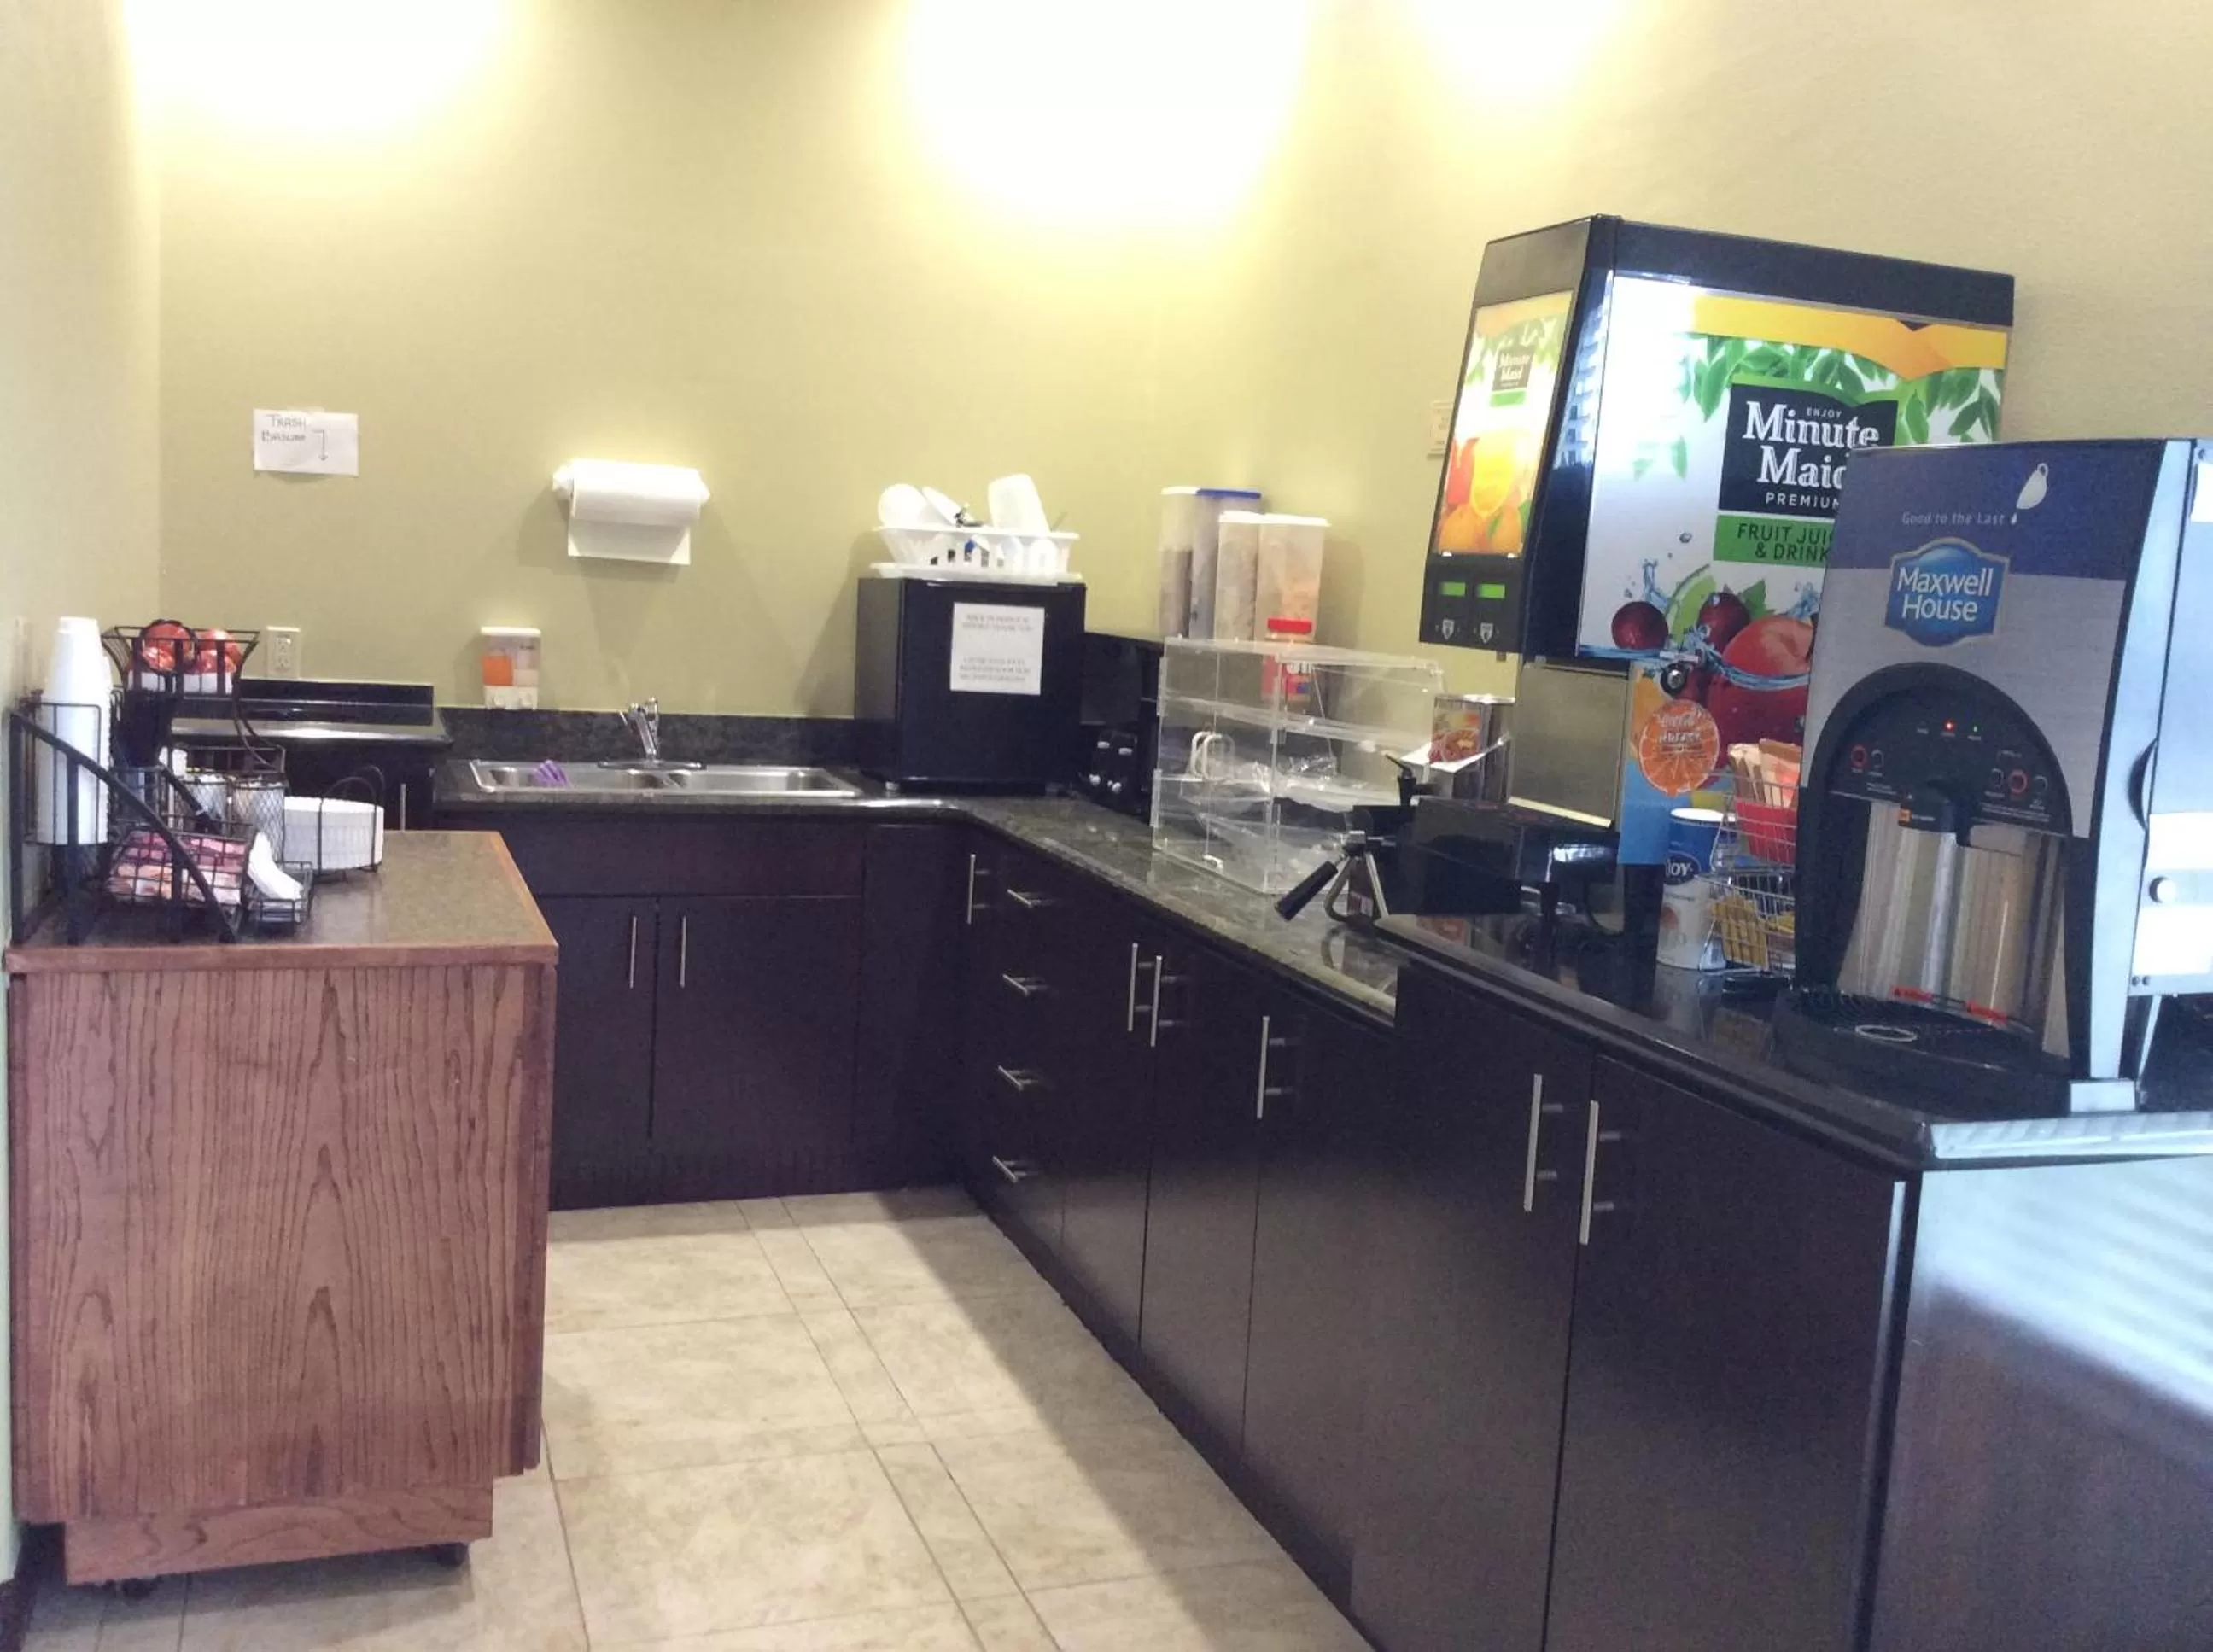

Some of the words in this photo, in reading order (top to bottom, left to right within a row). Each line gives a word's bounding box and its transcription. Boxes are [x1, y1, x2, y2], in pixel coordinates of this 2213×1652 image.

[1806, 407, 1842, 419] ENJOY
[1742, 400, 1880, 448] Minute
[1901, 511, 1931, 526] Good
[1934, 512, 1948, 525] to
[1951, 511, 1972, 525] the
[1977, 511, 2006, 526] Last
[1737, 523, 1793, 543] FRUIT
[1755, 540, 1767, 559] &
[1896, 566, 1994, 597] Maxwell
[1901, 594, 1979, 622] House
